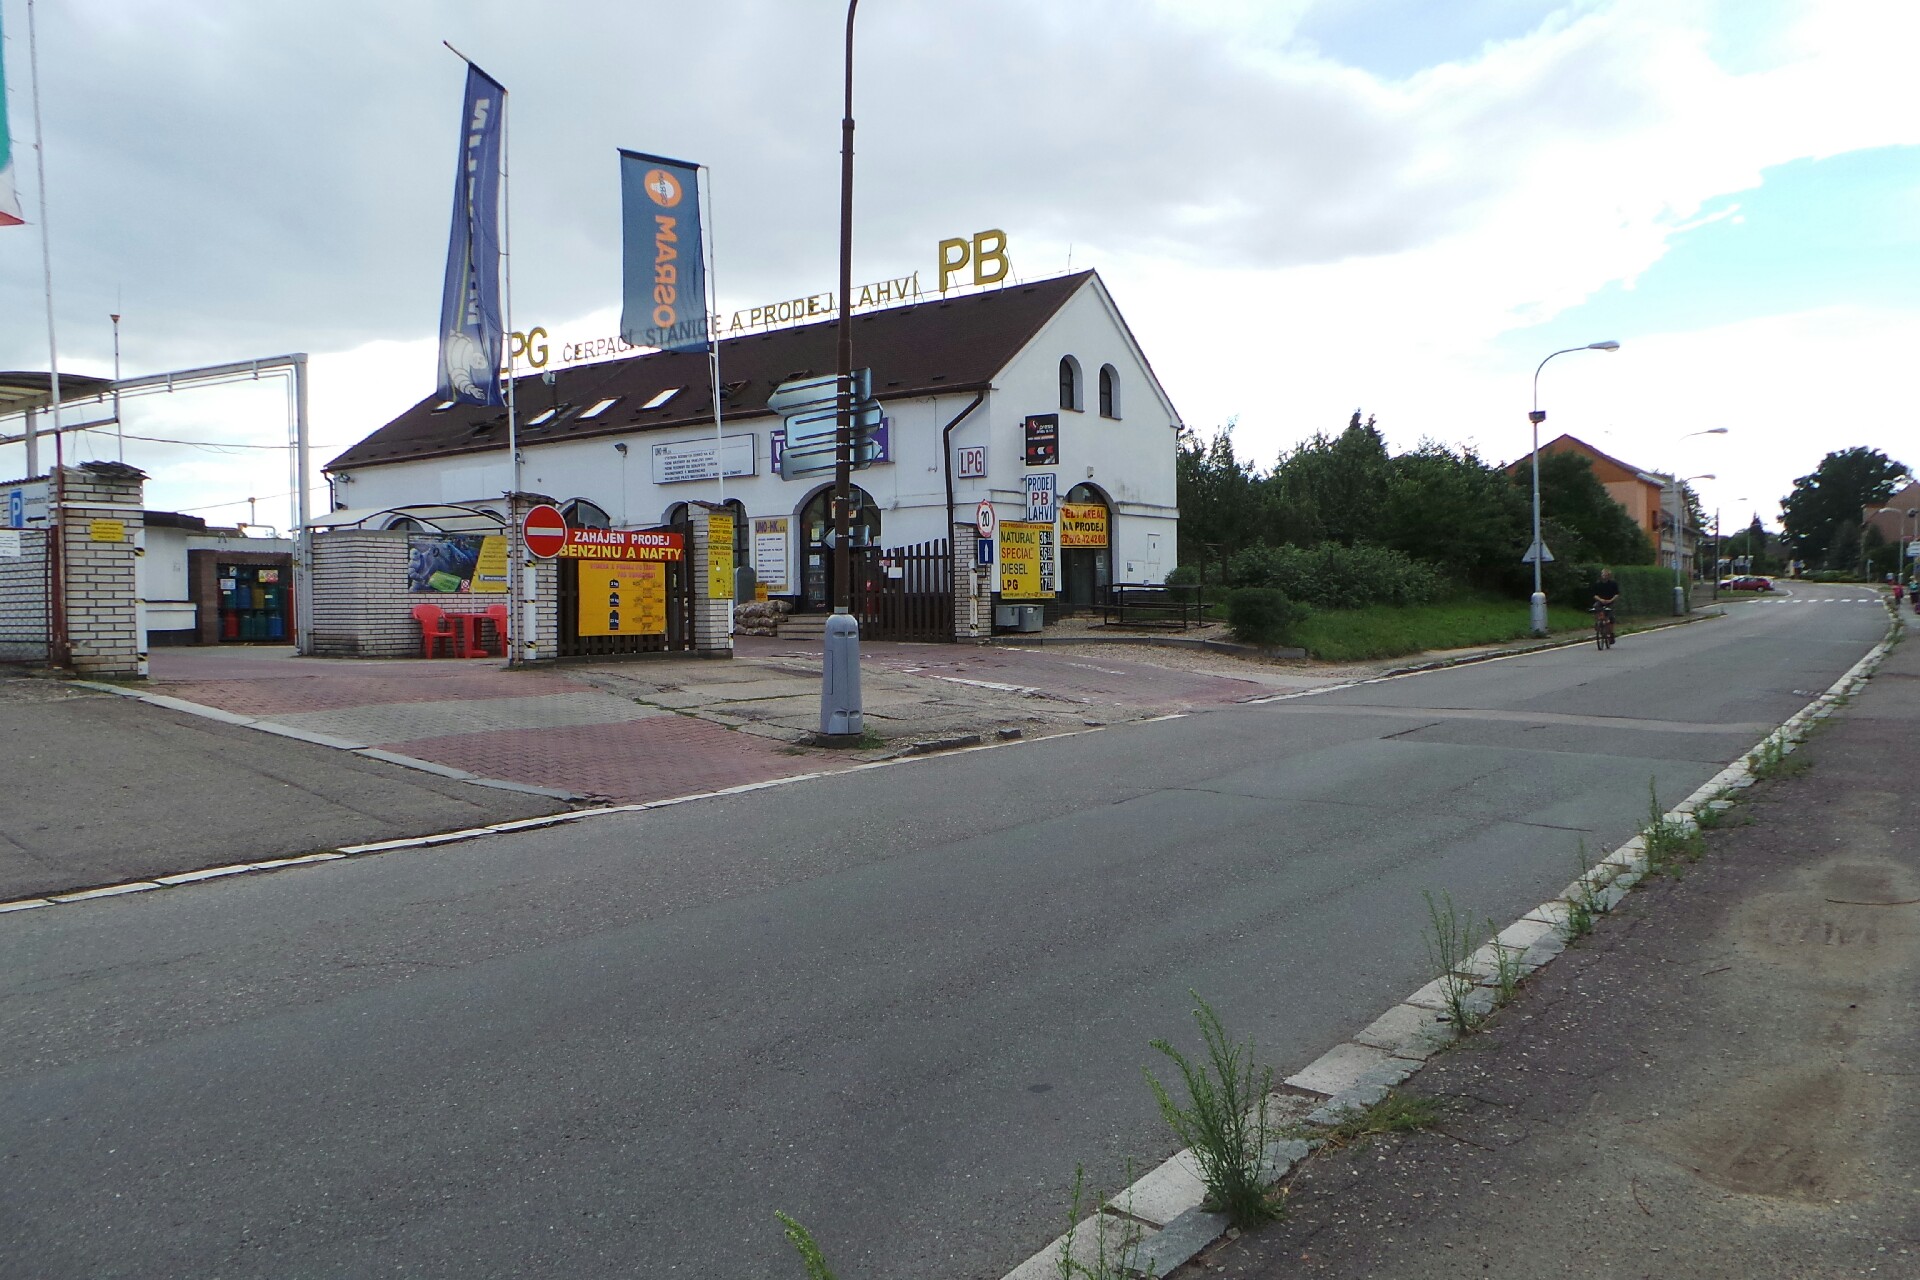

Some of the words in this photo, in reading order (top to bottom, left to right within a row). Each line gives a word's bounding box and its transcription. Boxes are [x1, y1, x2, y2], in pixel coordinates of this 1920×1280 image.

[938, 229, 1009, 292] PB
[730, 311, 744, 332] A
[750, 292, 833, 328] PRODEJ
[850, 271, 918, 308] AHVÍ
[960, 450, 983, 474] LPG
[1027, 476, 1053, 492] PRODEJ
[1031, 491, 1049, 506] PB
[980, 511, 990, 527] 20
[1028, 503, 1053, 521] LAHVÍ
[1062, 521, 1074, 531] NA
[1075, 522, 1104, 532] PRODEJ
[574, 530, 625, 544] ZAHÁJEN
[631, 533, 670, 546] PRODEJ
[559, 545, 622, 558] BENZINU
[626, 547, 636, 559] A
[640, 547, 682, 560] NAFTY
[1002, 563, 1028, 575] DIESEL
[1002, 579, 1019, 590] LPG
